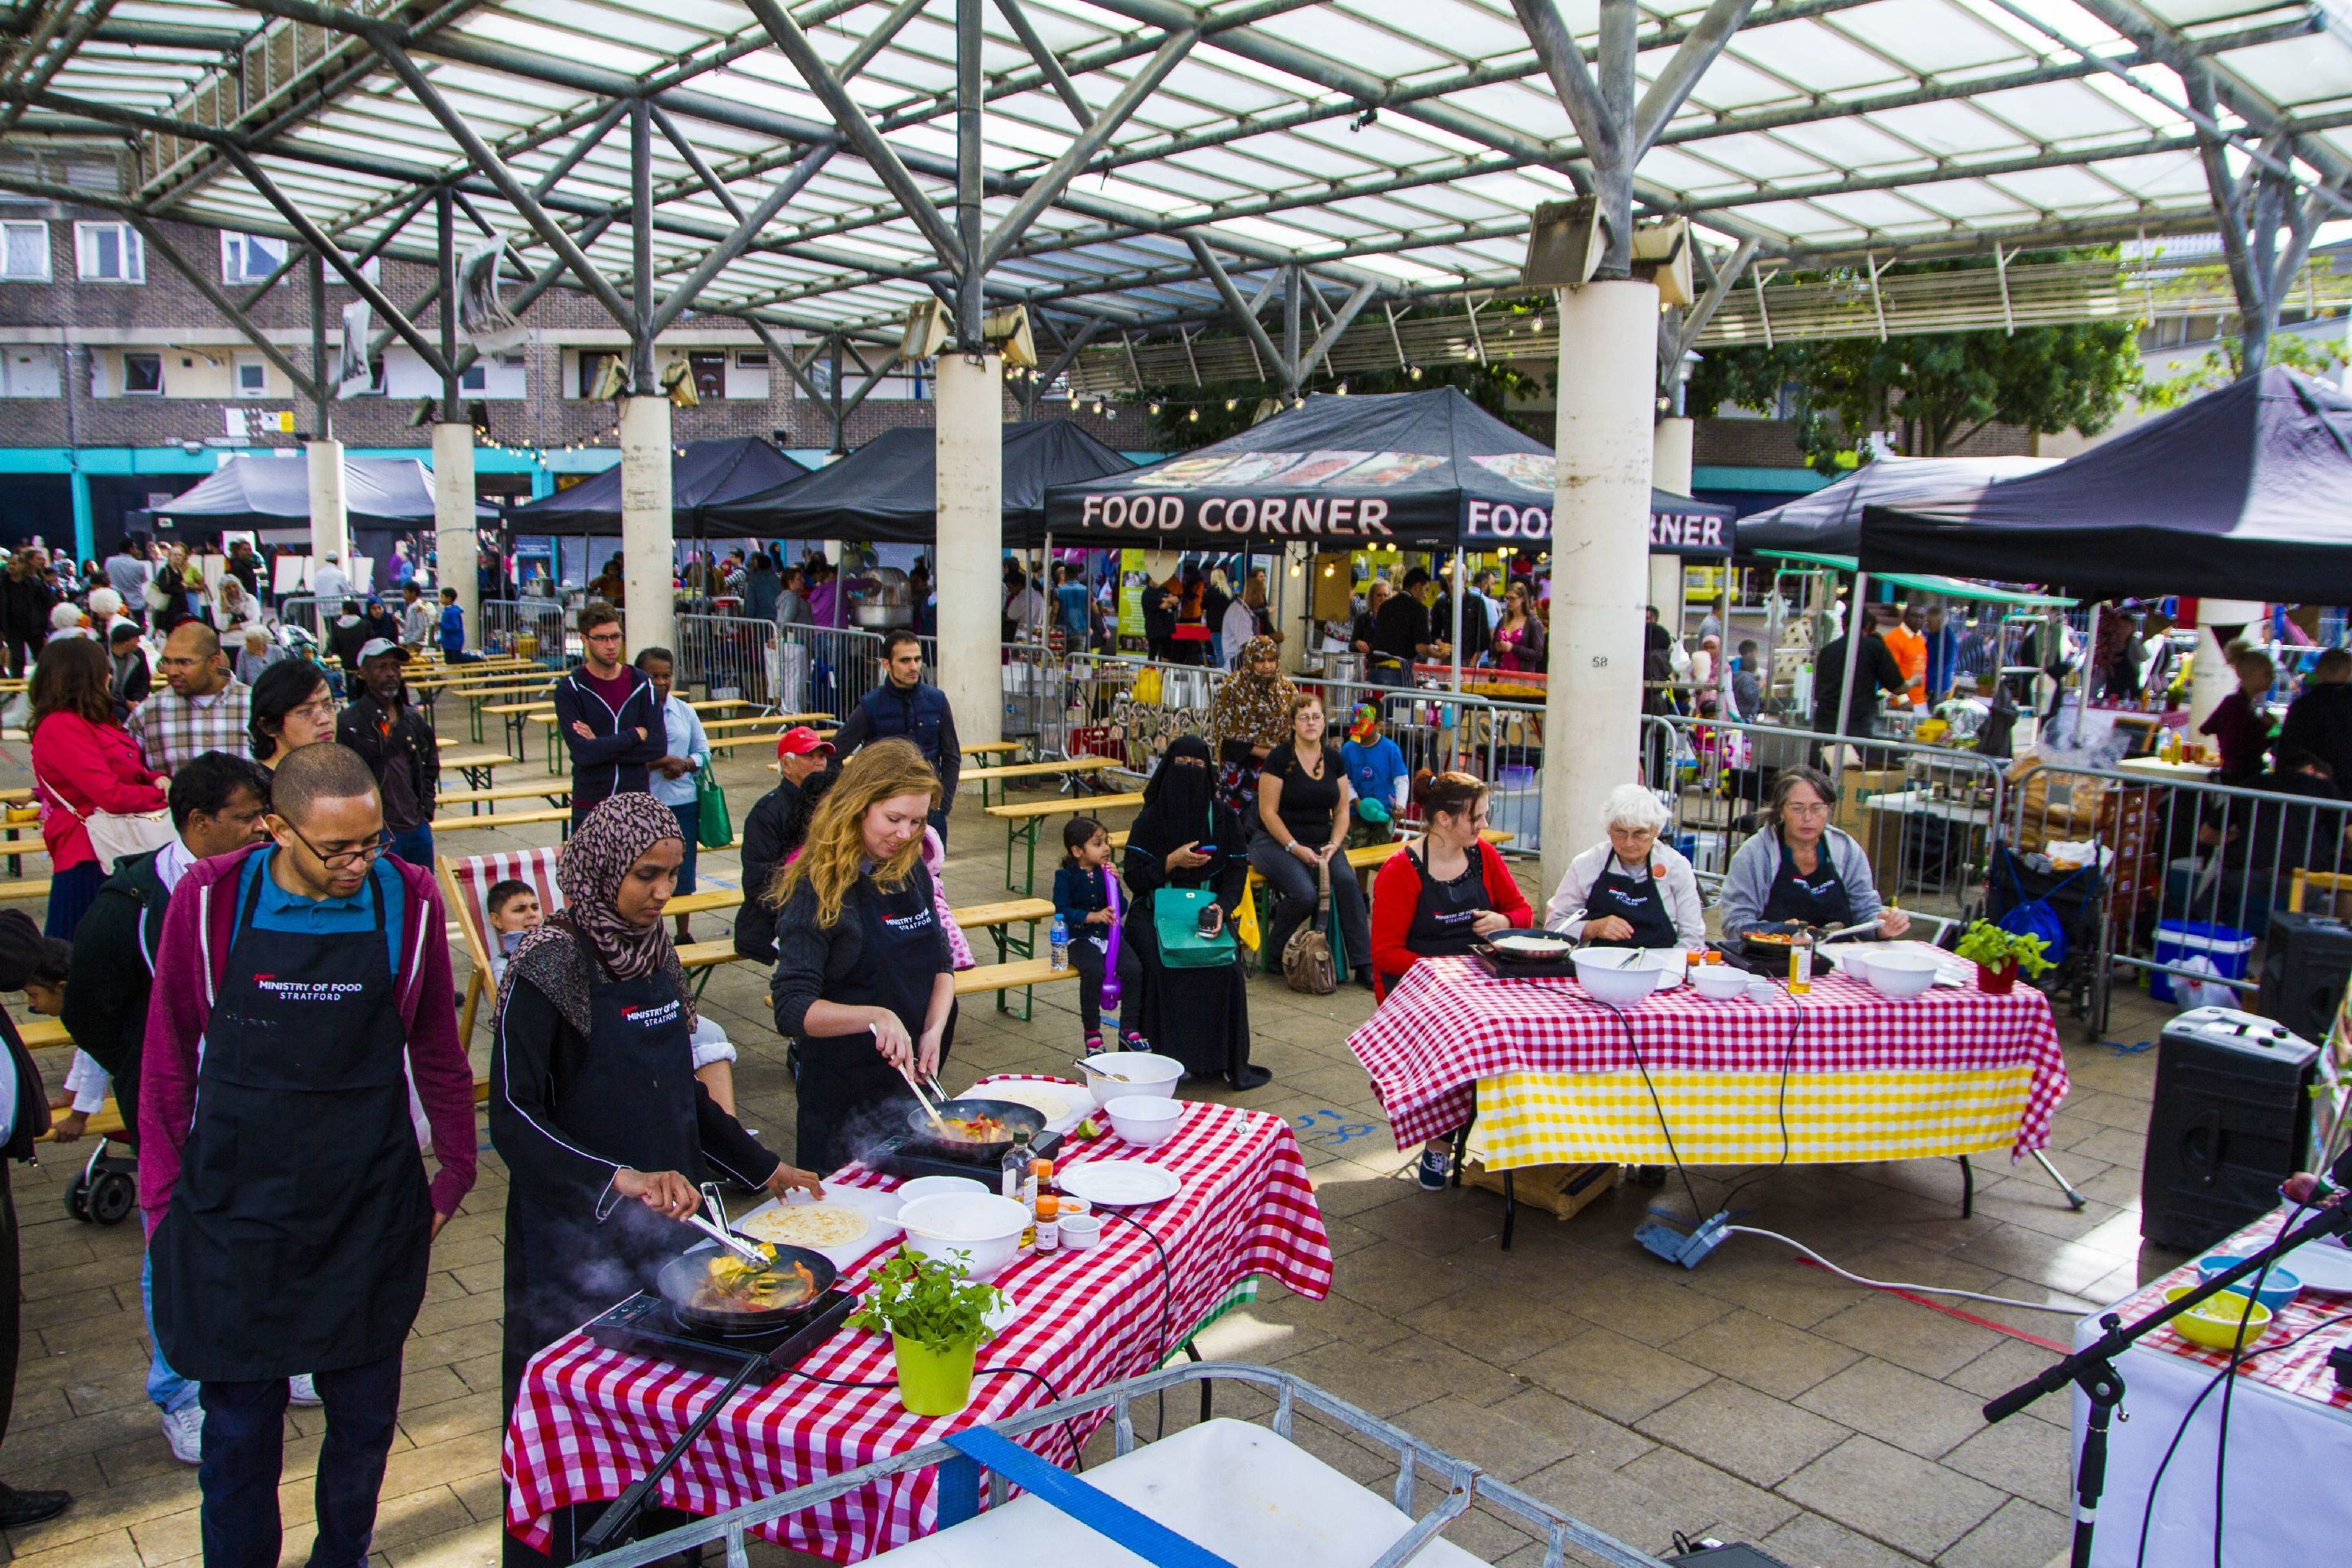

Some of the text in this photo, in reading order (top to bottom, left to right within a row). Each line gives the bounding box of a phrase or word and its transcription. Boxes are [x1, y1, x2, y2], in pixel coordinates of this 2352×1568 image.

[1082, 495, 1394, 536] FOOD CORNER
[1468, 499, 1554, 540] FOO
[1592, 655, 1607, 668] 58
[259, 980, 310, 991] MINISTRY
[331, 983, 363, 992] FOOD
[280, 991, 341, 1001] STRATFORD
[627, 1007, 663, 1021] MINISTRY
[663, 1003, 671, 1013] OF
